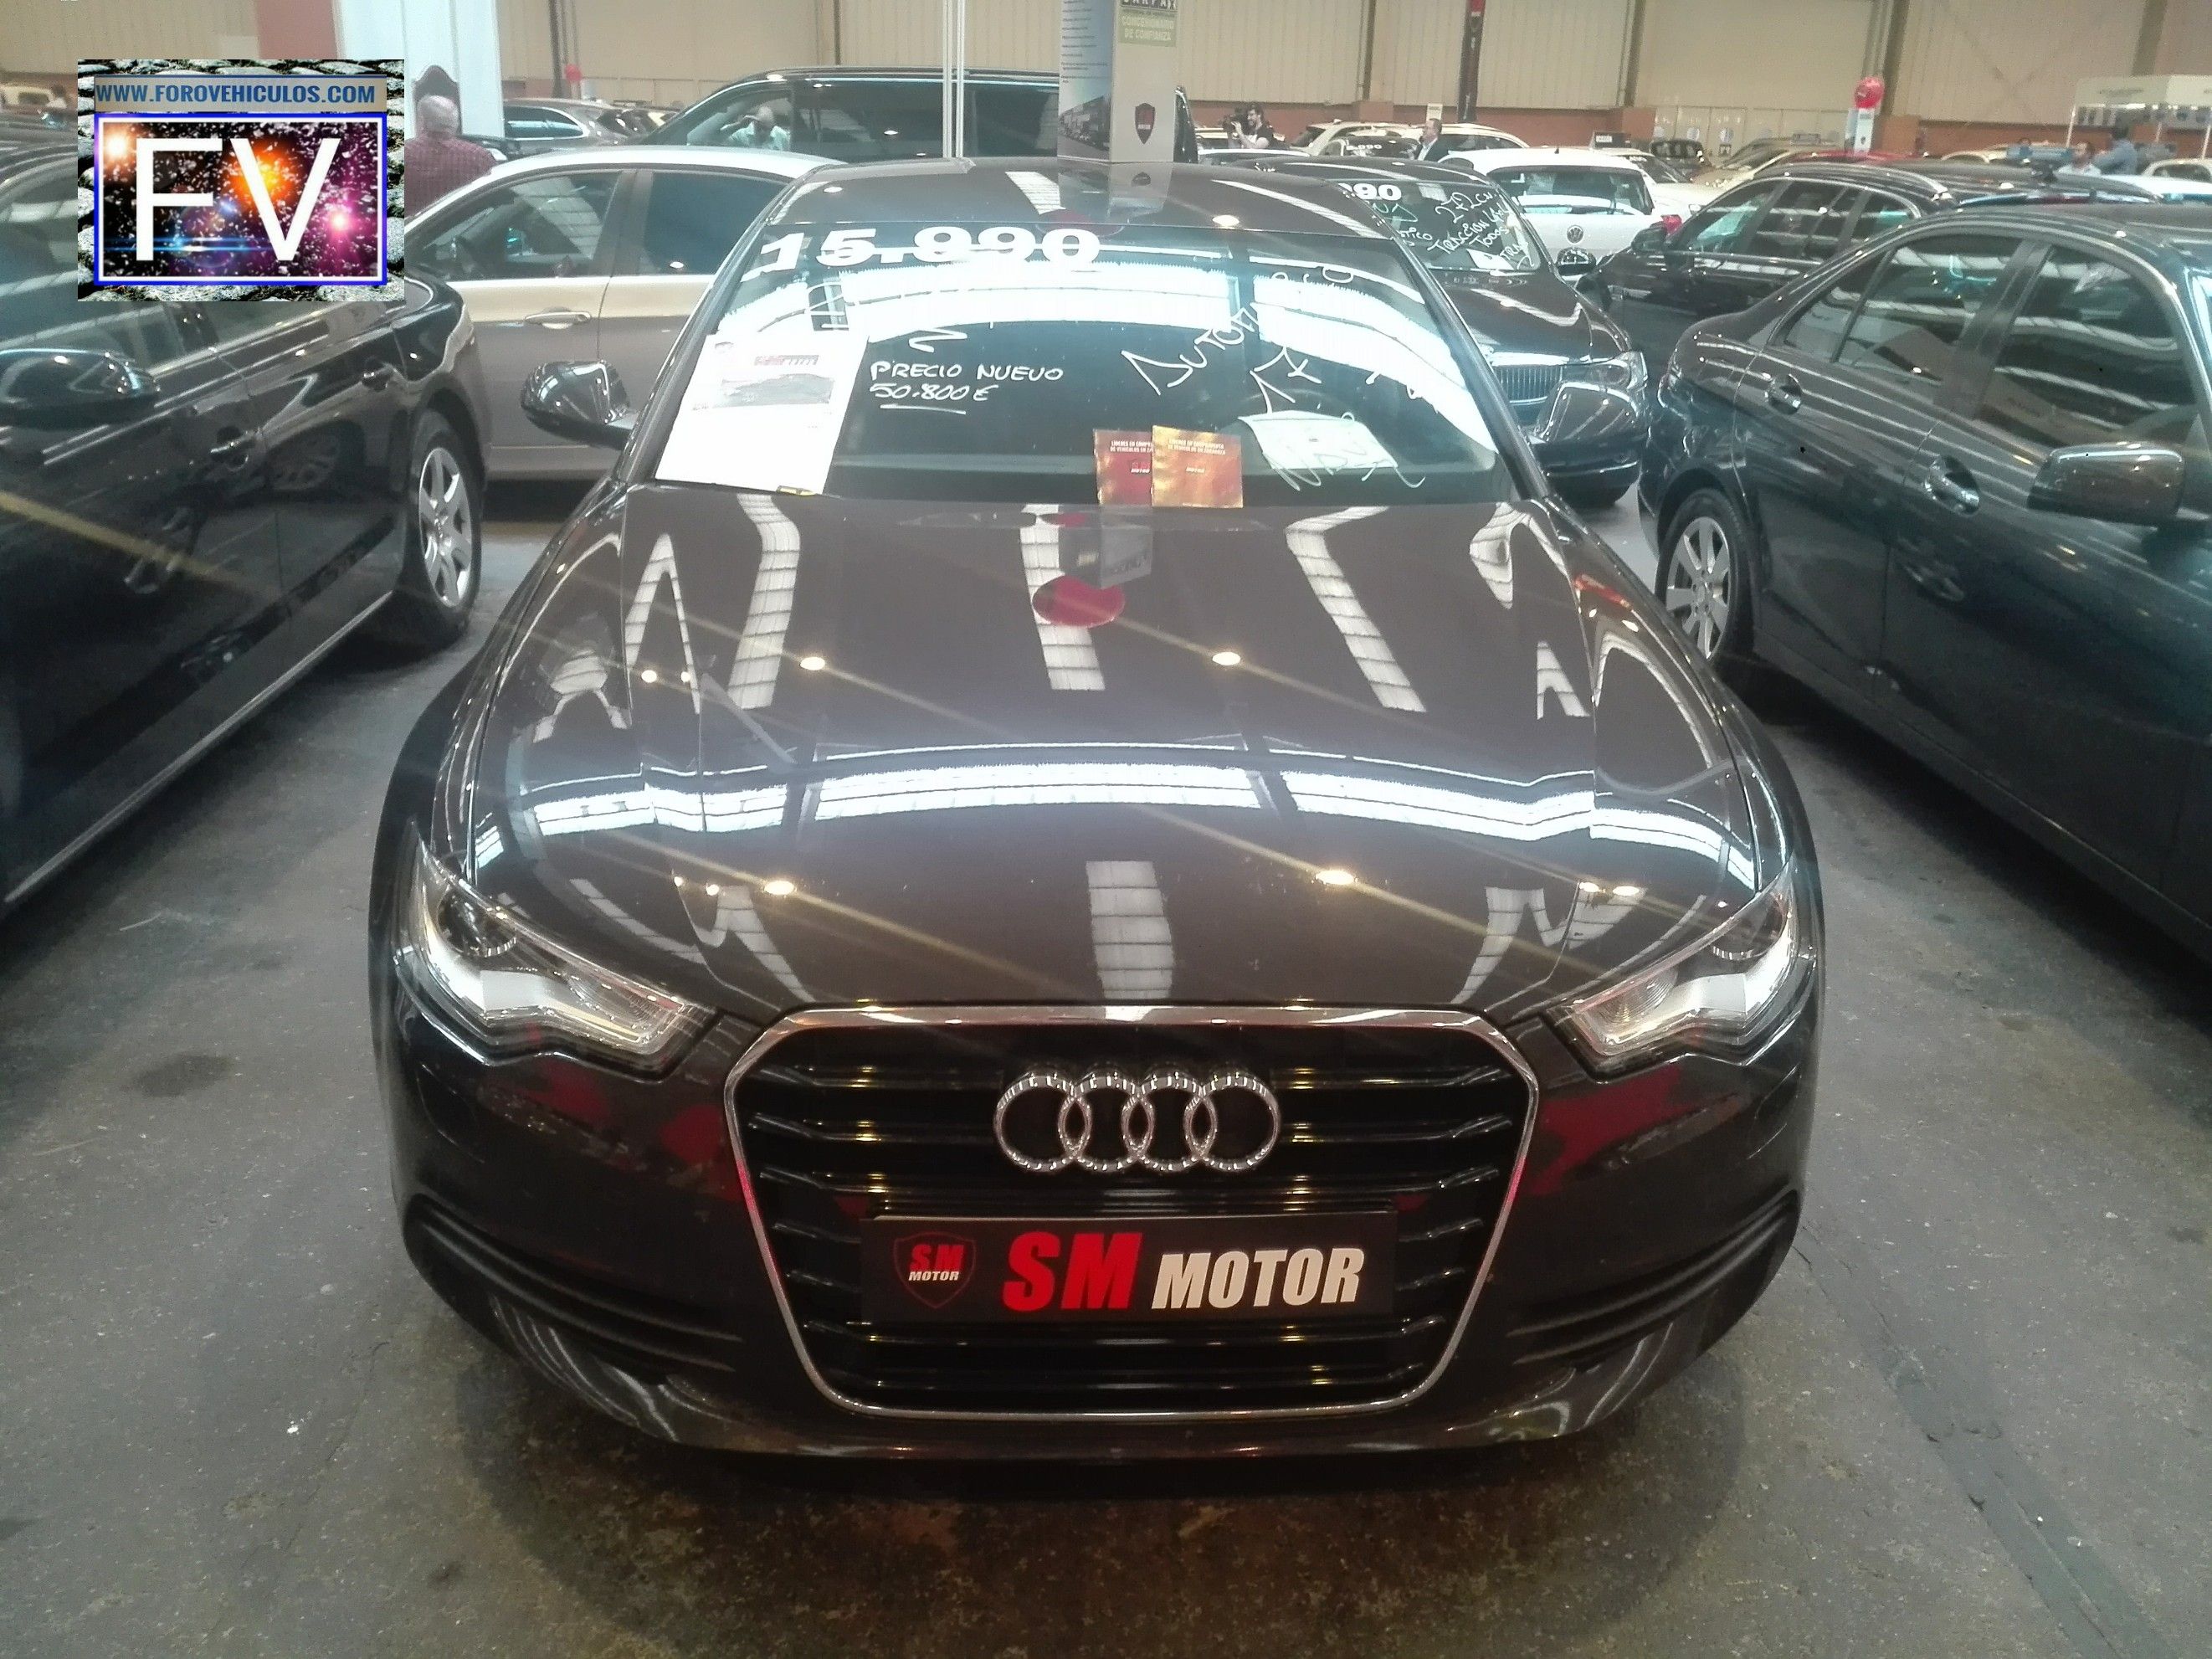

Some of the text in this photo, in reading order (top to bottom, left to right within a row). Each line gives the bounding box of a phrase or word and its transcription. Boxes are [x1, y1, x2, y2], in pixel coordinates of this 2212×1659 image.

[760, 226, 1101, 271] 15.990
[870, 362, 962, 381] PRECIO
[909, 1243, 965, 1271] SM
[908, 1271, 960, 1281] MOTOR
[1003, 1231, 1365, 1312] SM MOTOR
